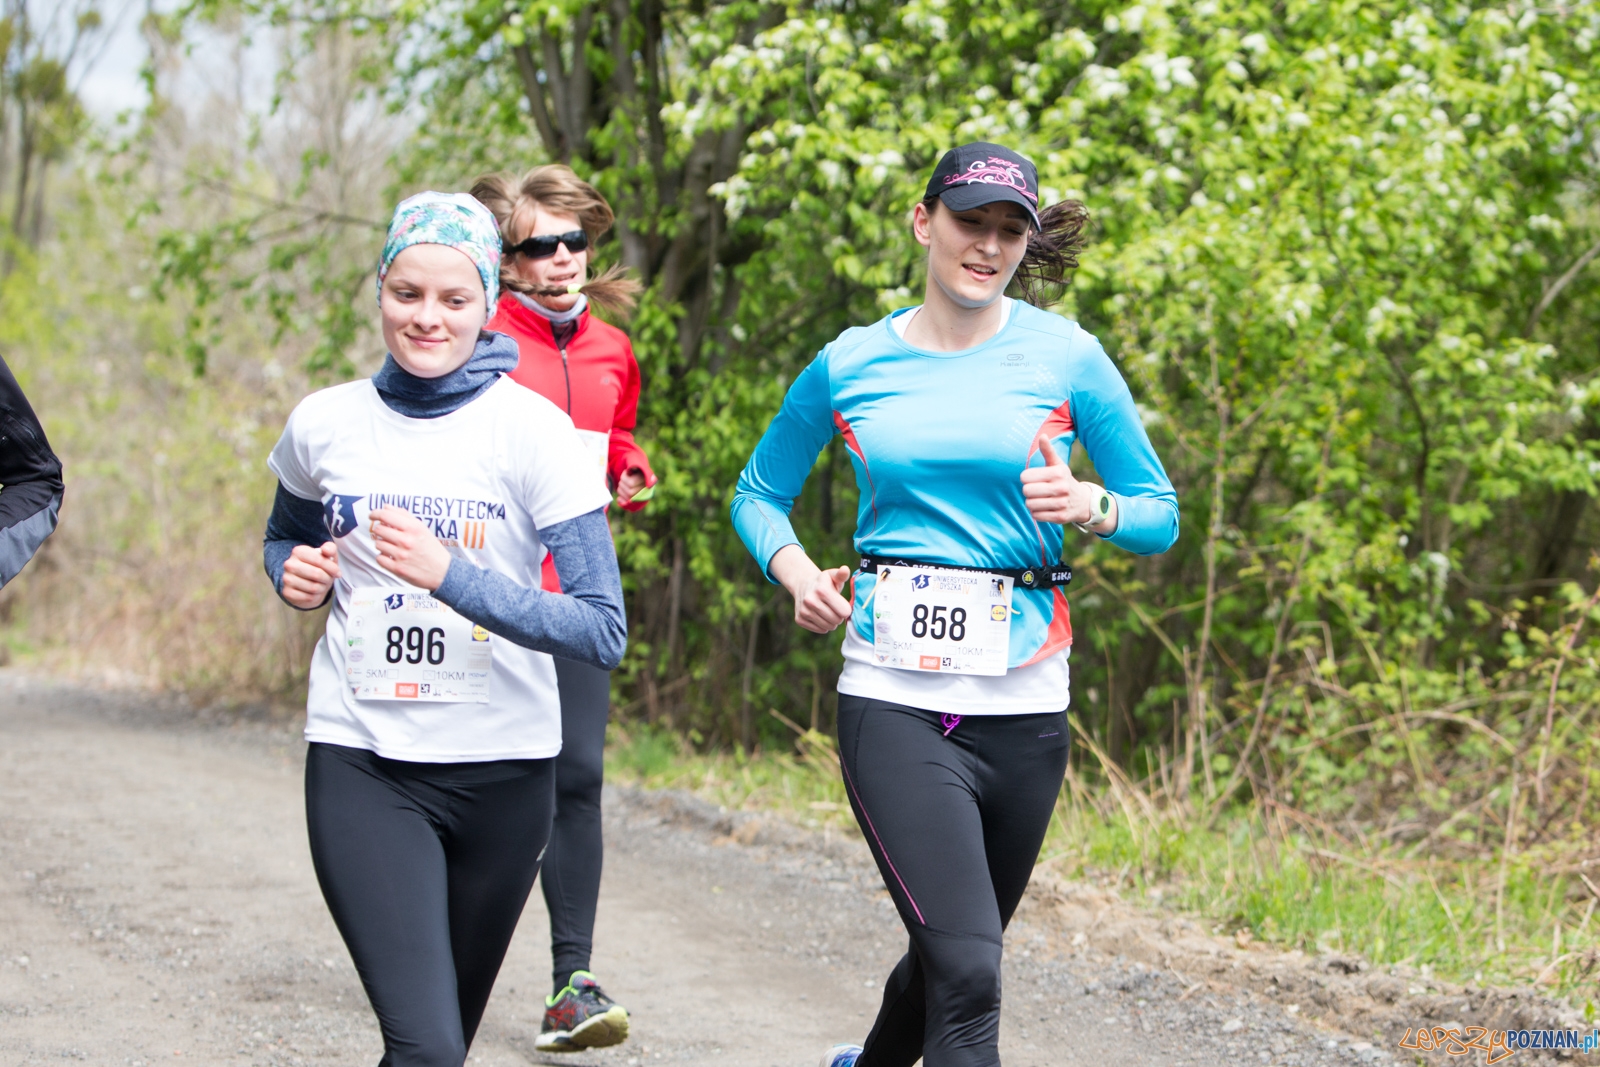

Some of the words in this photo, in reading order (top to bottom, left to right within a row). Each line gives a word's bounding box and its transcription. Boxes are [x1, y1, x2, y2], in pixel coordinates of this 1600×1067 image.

[369, 493, 506, 520] UNIWERSYTECKA
[463, 521, 486, 550] III
[911, 604, 967, 642] 858
[385, 625, 446, 666] 896
[893, 641, 913, 651] 5KM
[957, 646, 983, 656] 10KM
[365, 669, 387, 679] 5KM
[436, 670, 465, 681] 10KM
